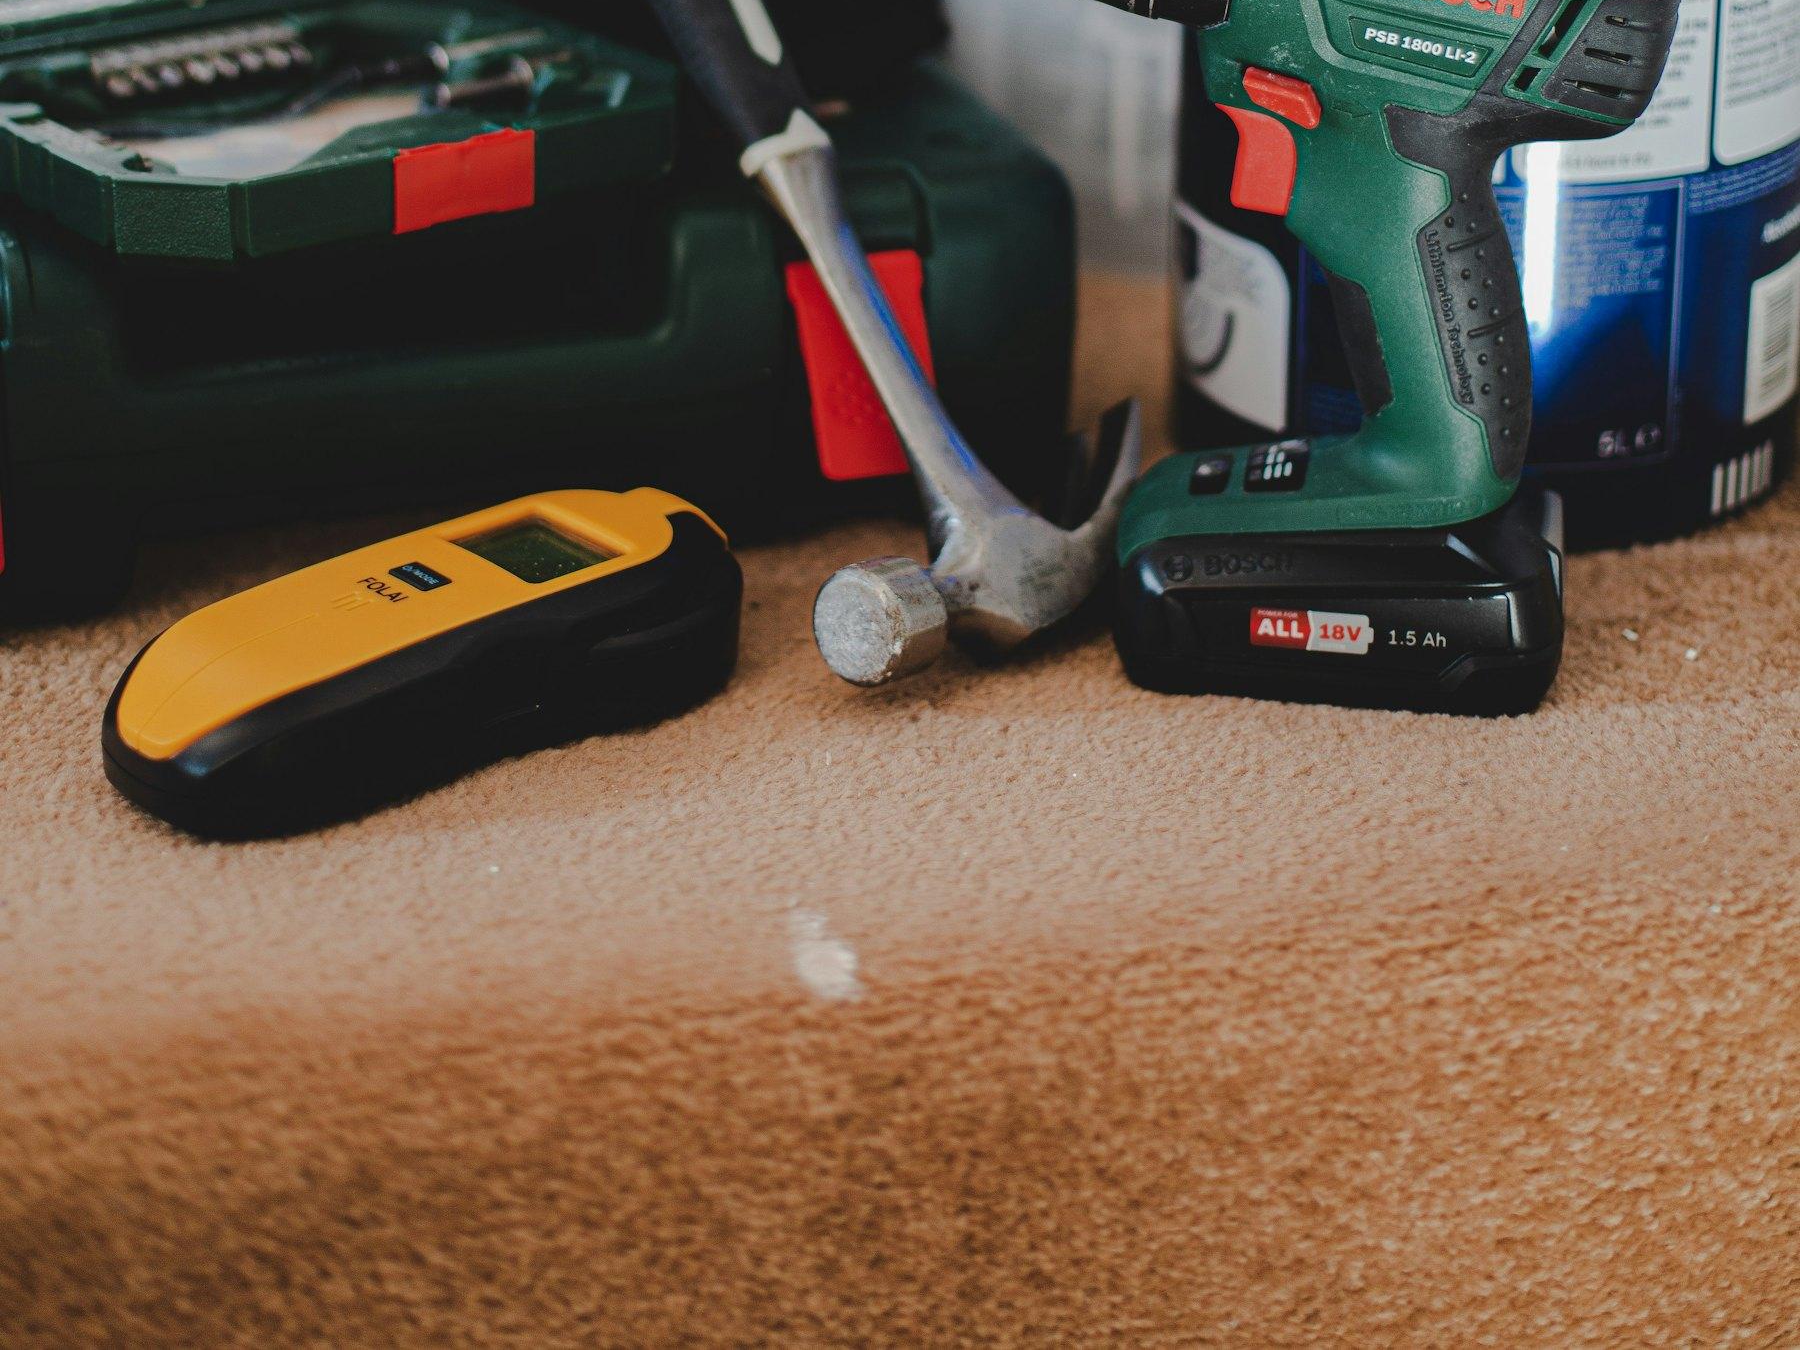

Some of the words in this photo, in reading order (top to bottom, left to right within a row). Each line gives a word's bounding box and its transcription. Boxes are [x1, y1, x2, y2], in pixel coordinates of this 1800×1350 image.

[1364, 27, 1400, 46] PSB
[1402, 35, 1443, 57] 1800
[1444, 45, 1478, 64] LI-2
[1447, 323, 1475, 405] Technology
[1203, 552, 1293, 577] BOSCH
[356, 576, 410, 603] FOLAI
[1256, 617, 1304, 639] ALL
[1318, 622, 1363, 642] 18V
[1388, 630, 1417, 647] 1.5
[1423, 631, 1448, 648] Ah
